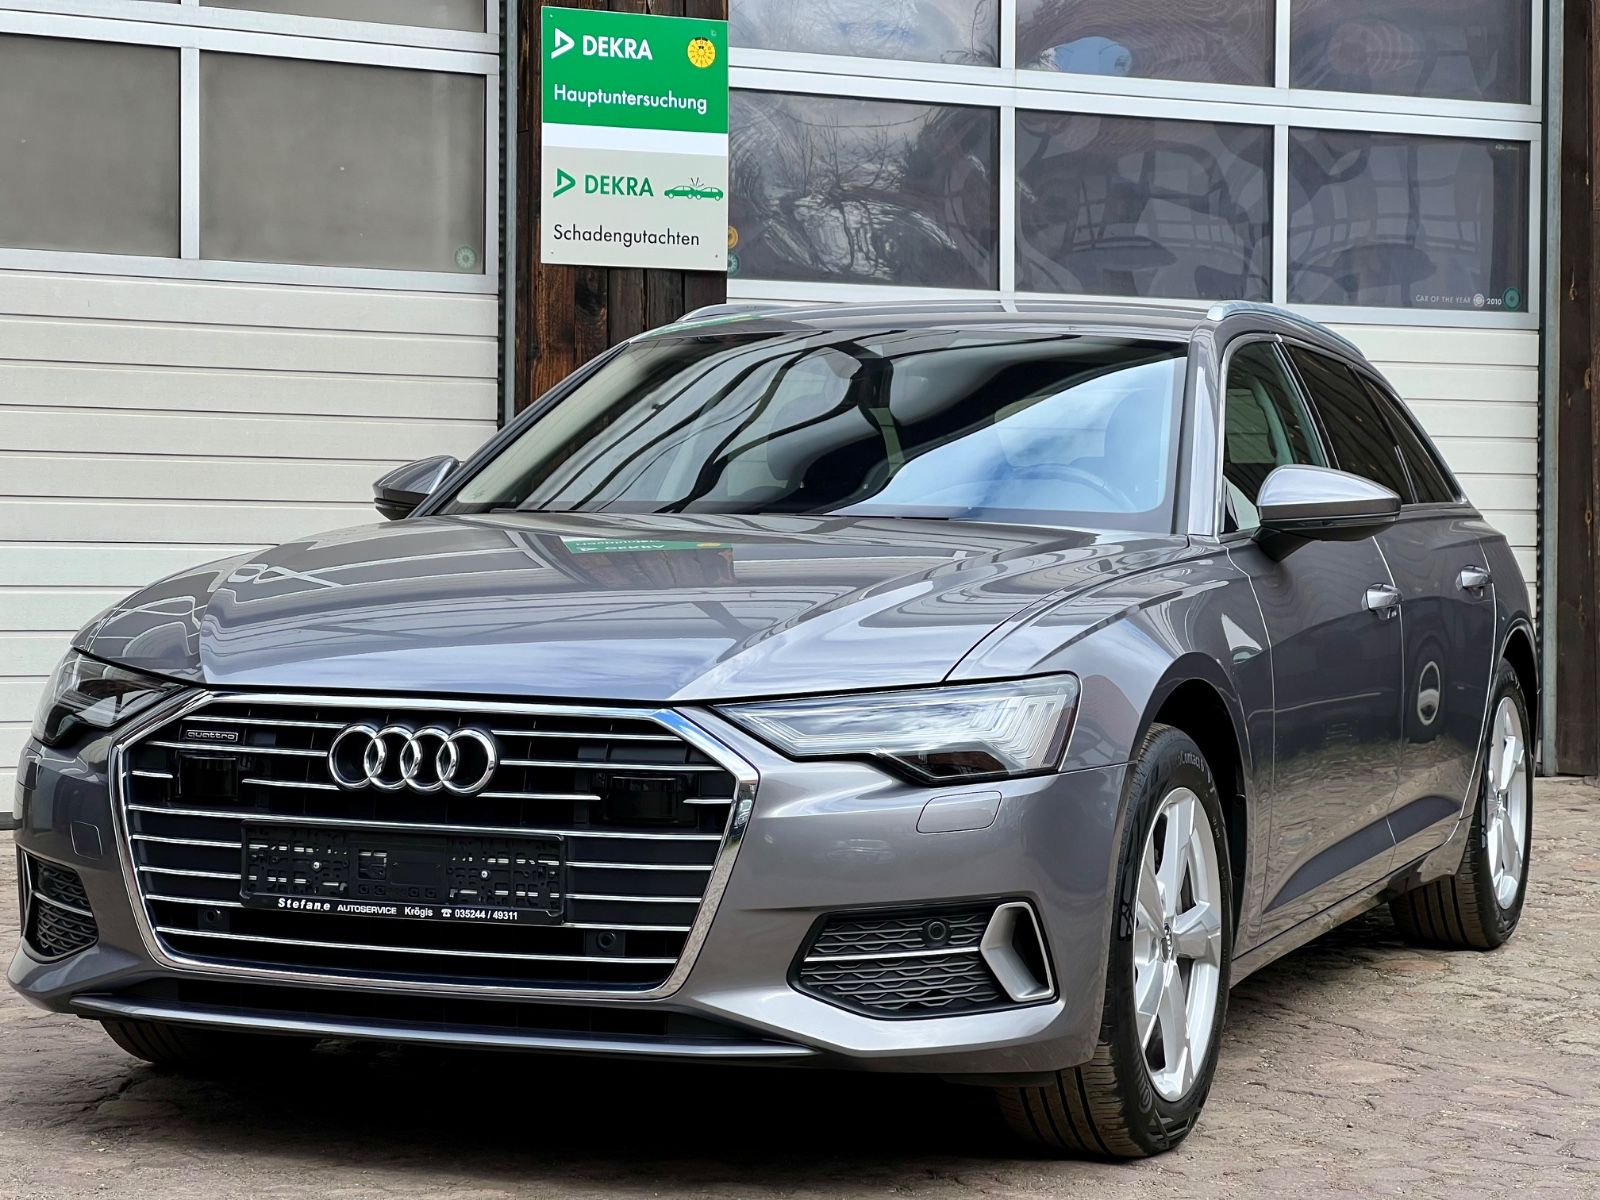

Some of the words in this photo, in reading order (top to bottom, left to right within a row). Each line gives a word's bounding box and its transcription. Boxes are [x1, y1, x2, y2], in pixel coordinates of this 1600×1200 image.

[582, 34, 653, 61] DEKRA
[554, 83, 707, 115] Hauptuntersuchung
[584, 174, 654, 197] DEKRA
[553, 224, 700, 248] Schadengutachten
[1415, 294, 1429, 302] CAR
[1430, 295, 1440, 303] OF
[1441, 296, 1453, 304] THE
[1456, 296, 1471, 304] YEAR
[1486, 297, 1502, 306] 2010
[187, 731, 235, 740] quattro
[337, 904, 397, 914] AUTOSERVICE
[404, 906, 433, 918] Krögis
[454, 909, 486, 919] 035244
[492, 910, 518, 920] 49311
